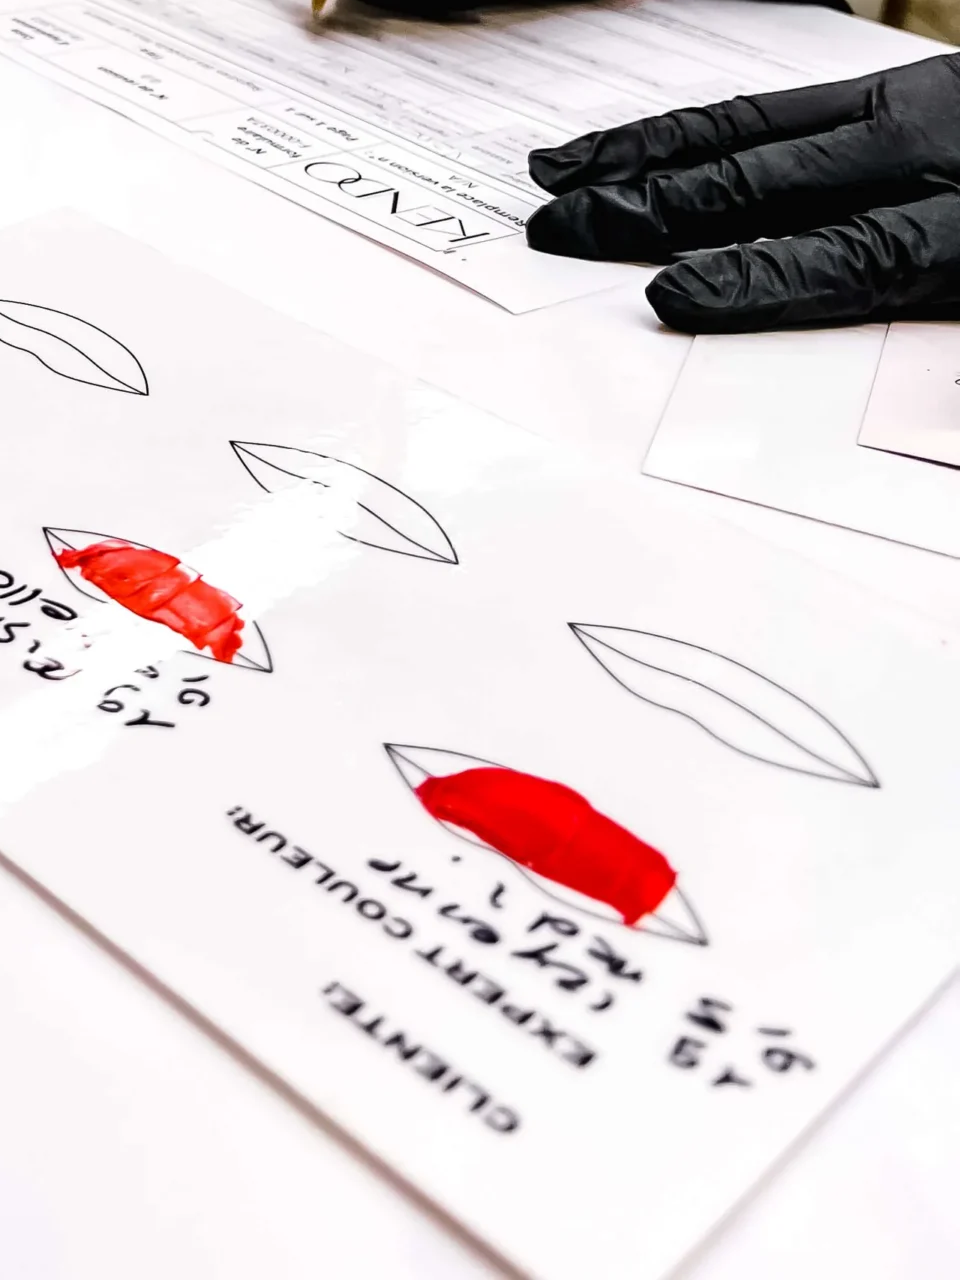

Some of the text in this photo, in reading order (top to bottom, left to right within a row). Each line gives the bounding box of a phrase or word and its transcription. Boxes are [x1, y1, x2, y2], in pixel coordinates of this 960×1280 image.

[304, 161, 491, 243] KENDO
[389, 161, 440, 186] version
[440, 183, 456, 194] la
[456, 187, 528, 228] Remplace
[225, 804, 599, 1069] EXPERT COULEUR:
[321, 980, 522, 1135] CLIENTE:
